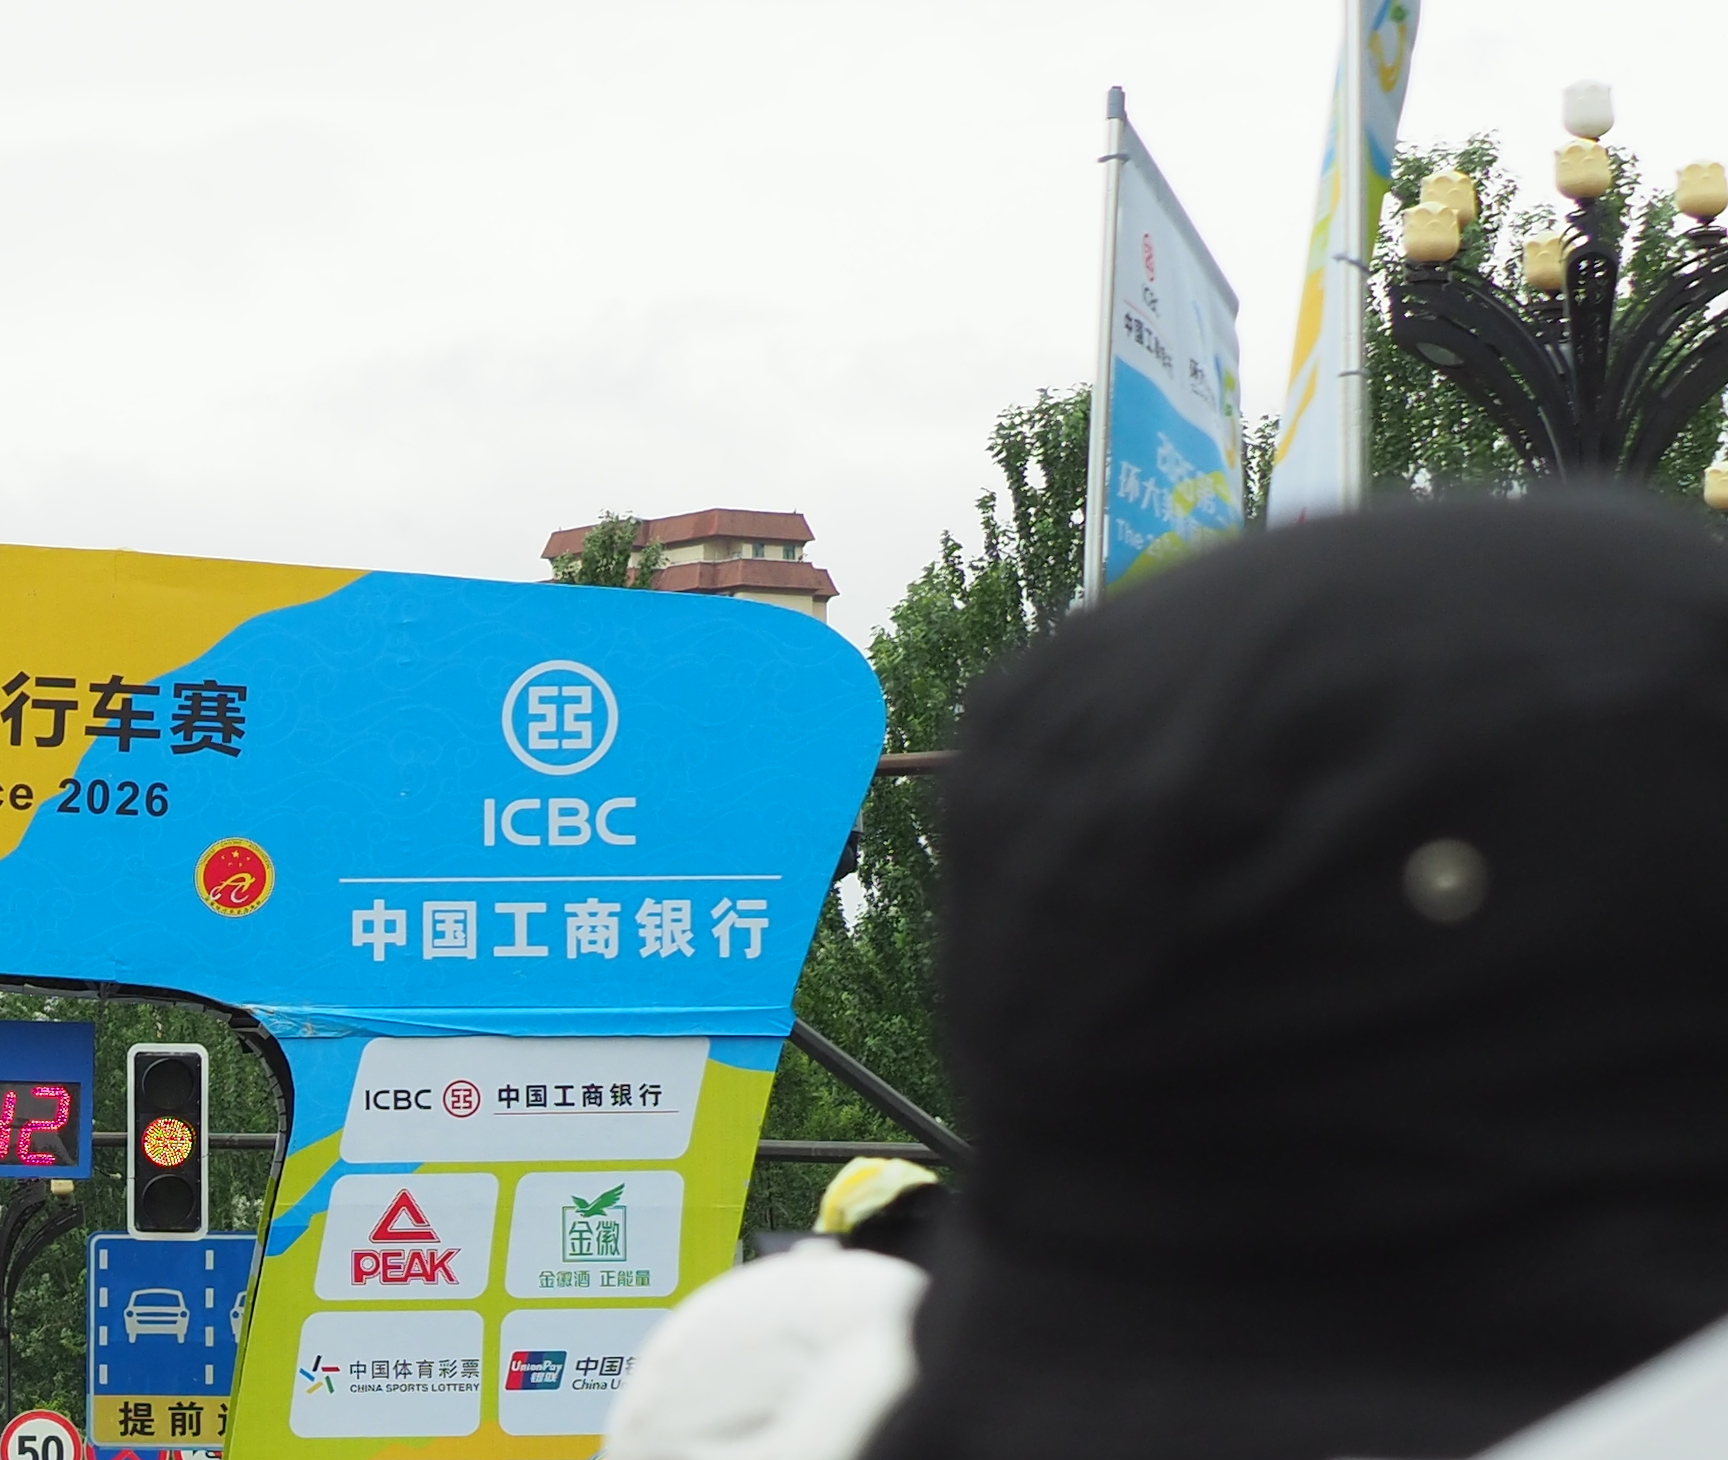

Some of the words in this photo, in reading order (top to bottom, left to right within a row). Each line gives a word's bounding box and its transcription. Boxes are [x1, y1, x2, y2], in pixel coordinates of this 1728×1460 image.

[57, 778, 170, 818] 2026
[483, 797, 637, 847] ICBC
[351, 897, 770, 962] 中国工商银行
[364, 1089, 432, 1110] ICBC
[498, 1083, 663, 1110] 中国工商银行
[567, 1218, 621, 1257] 金徽
[351, 1248, 461, 1286] PEAK
[349, 1358, 480, 1381] 中国体育彩票
[575, 1356, 635, 1377] 中国
[349, 1383, 383, 1393] CHINA
[386, 1383, 427, 1393] SPORTS
[430, 1382, 480, 1393] LOTTERY
[572, 1378, 609, 1391] China
[119, 1401, 227, 1437] 提前
